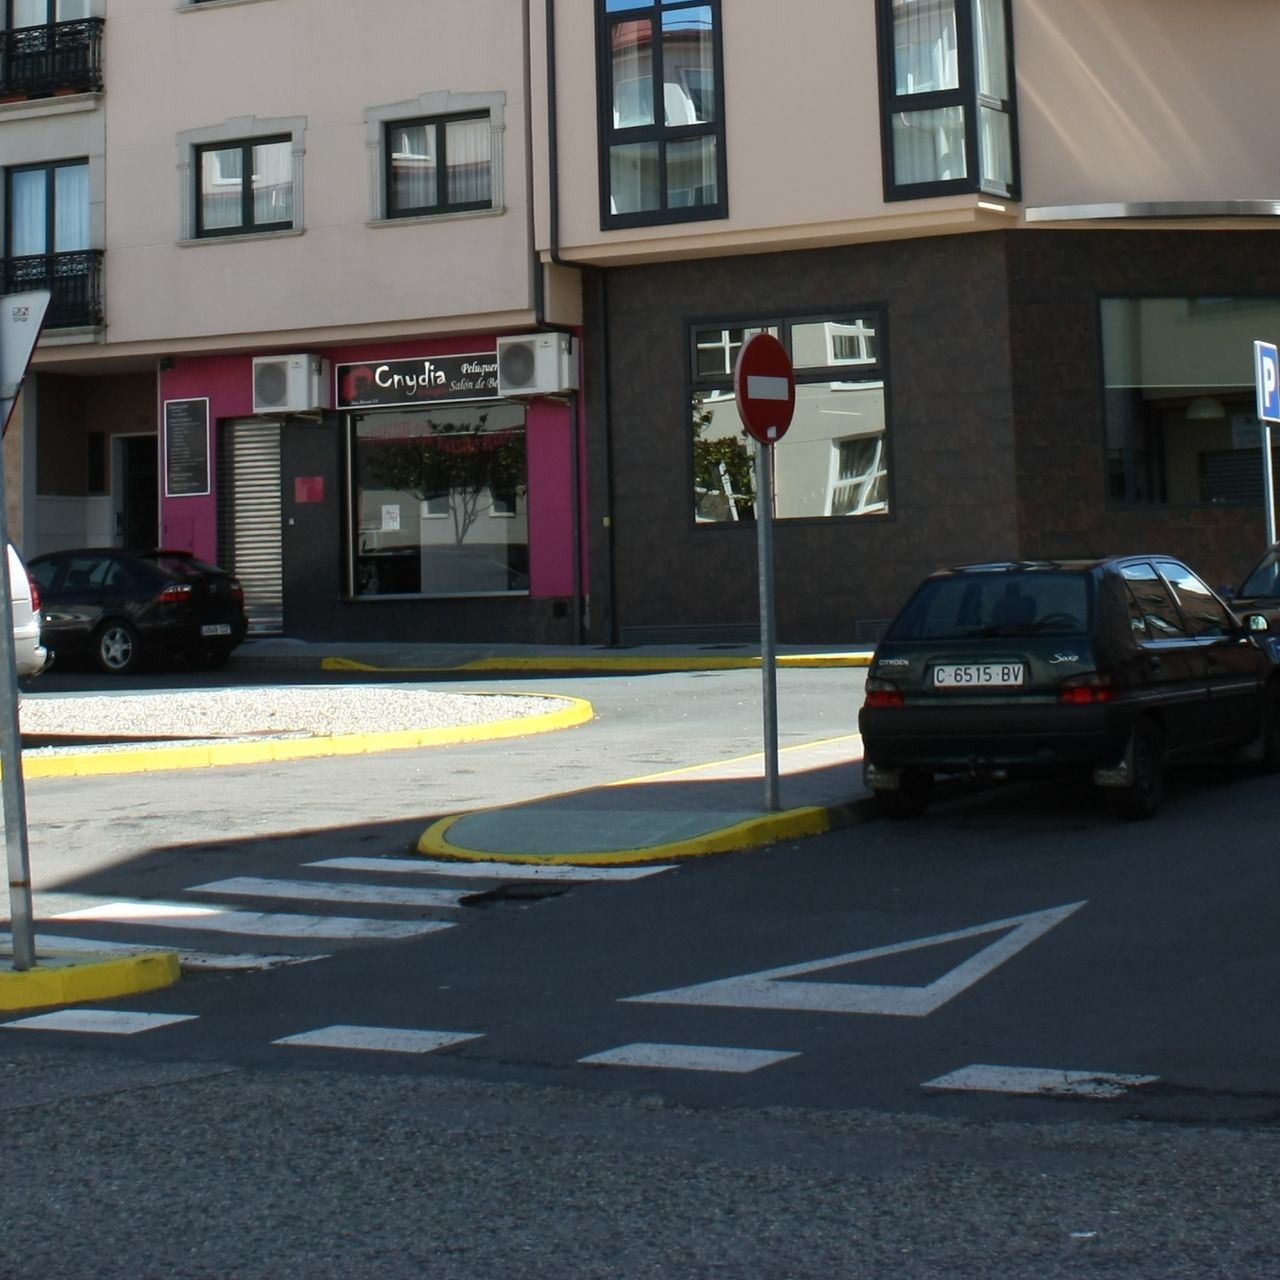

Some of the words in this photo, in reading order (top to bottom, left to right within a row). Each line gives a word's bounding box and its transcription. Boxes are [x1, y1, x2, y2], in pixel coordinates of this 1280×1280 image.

[374, 361, 447, 396] Cnydia
[474, 376, 485, 389] de
[1262, 356, 1276, 408] P
